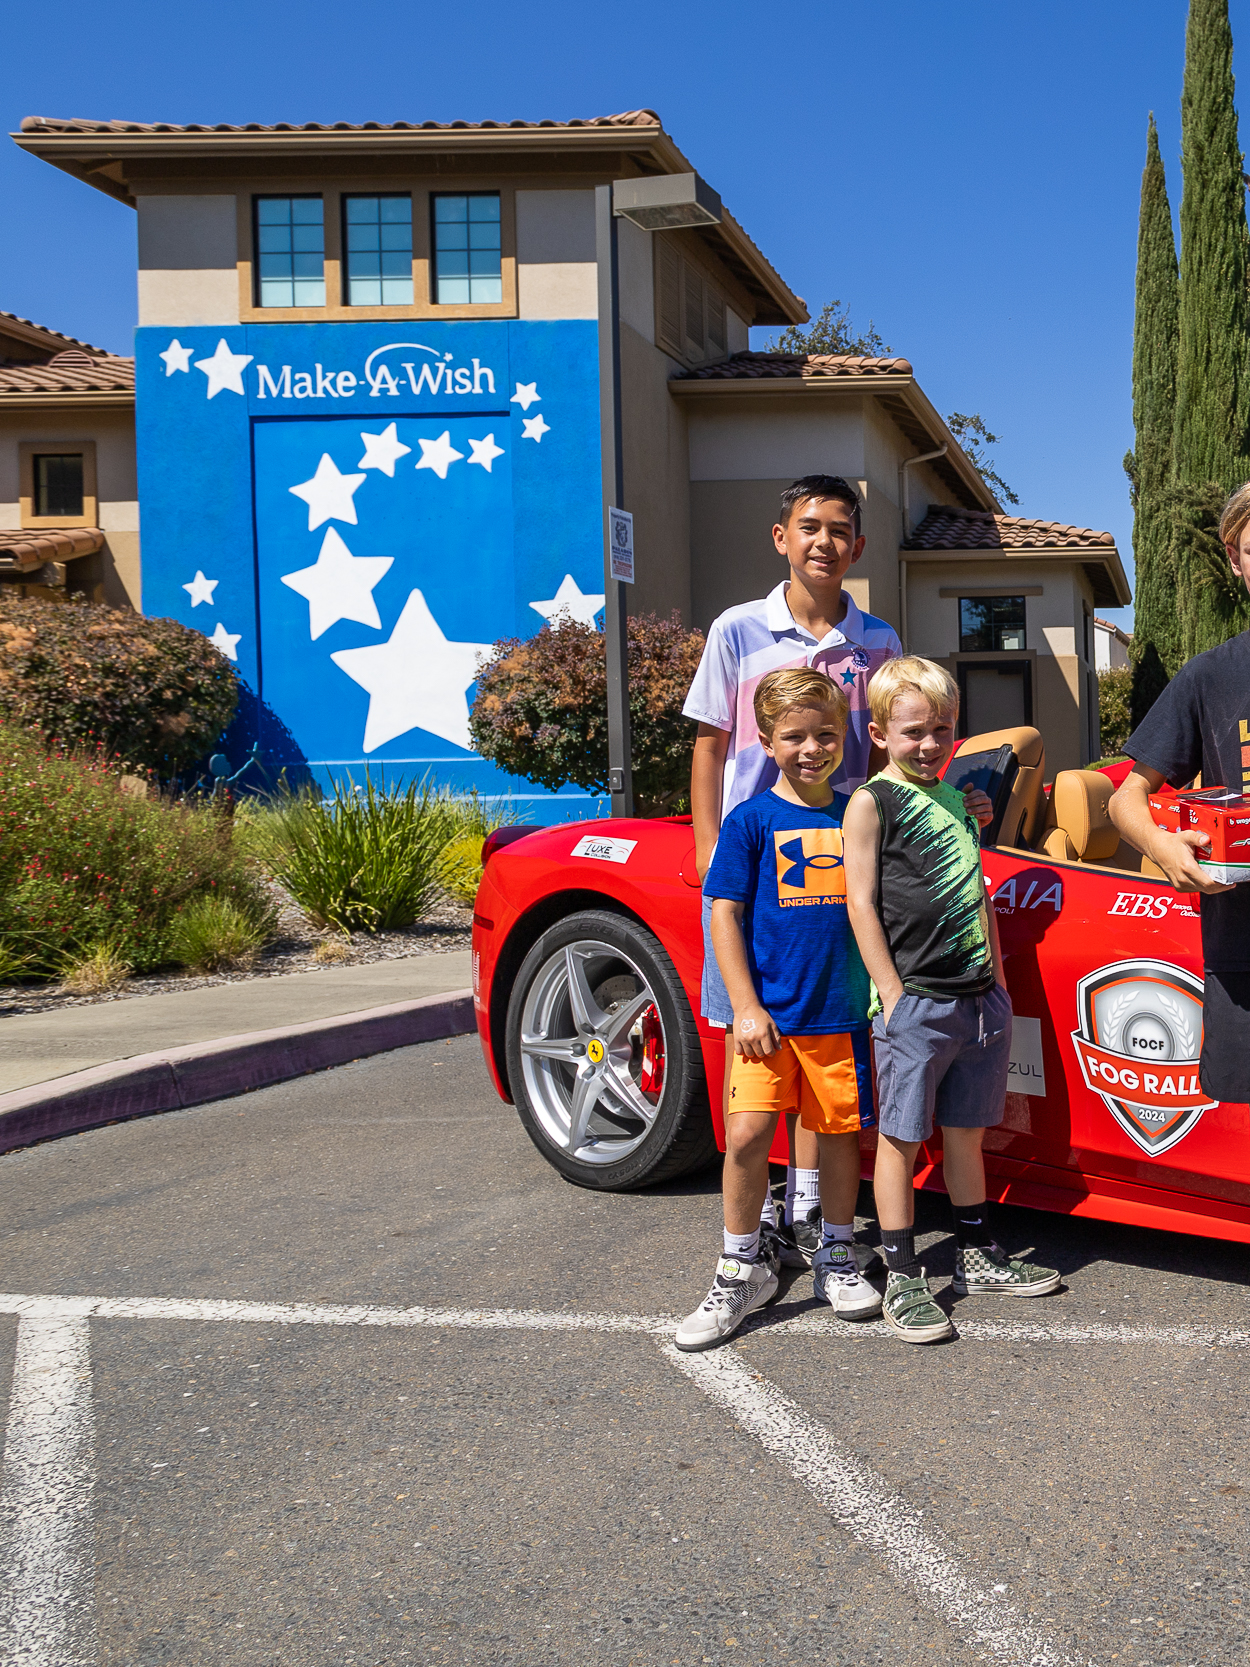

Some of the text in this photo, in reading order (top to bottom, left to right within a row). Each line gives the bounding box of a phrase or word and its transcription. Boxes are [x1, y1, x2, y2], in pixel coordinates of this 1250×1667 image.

[256, 343, 496, 399] Make-A-Wish
[779, 897, 848, 907] UNDER ARM
[984, 876, 1062, 912] AIA
[1107, 892, 1174, 919] EBS
[1132, 1037, 1165, 1051] FOCF
[1086, 1055, 1201, 1096] FOG RALL
[1138, 1109, 1166, 1123] 2024
